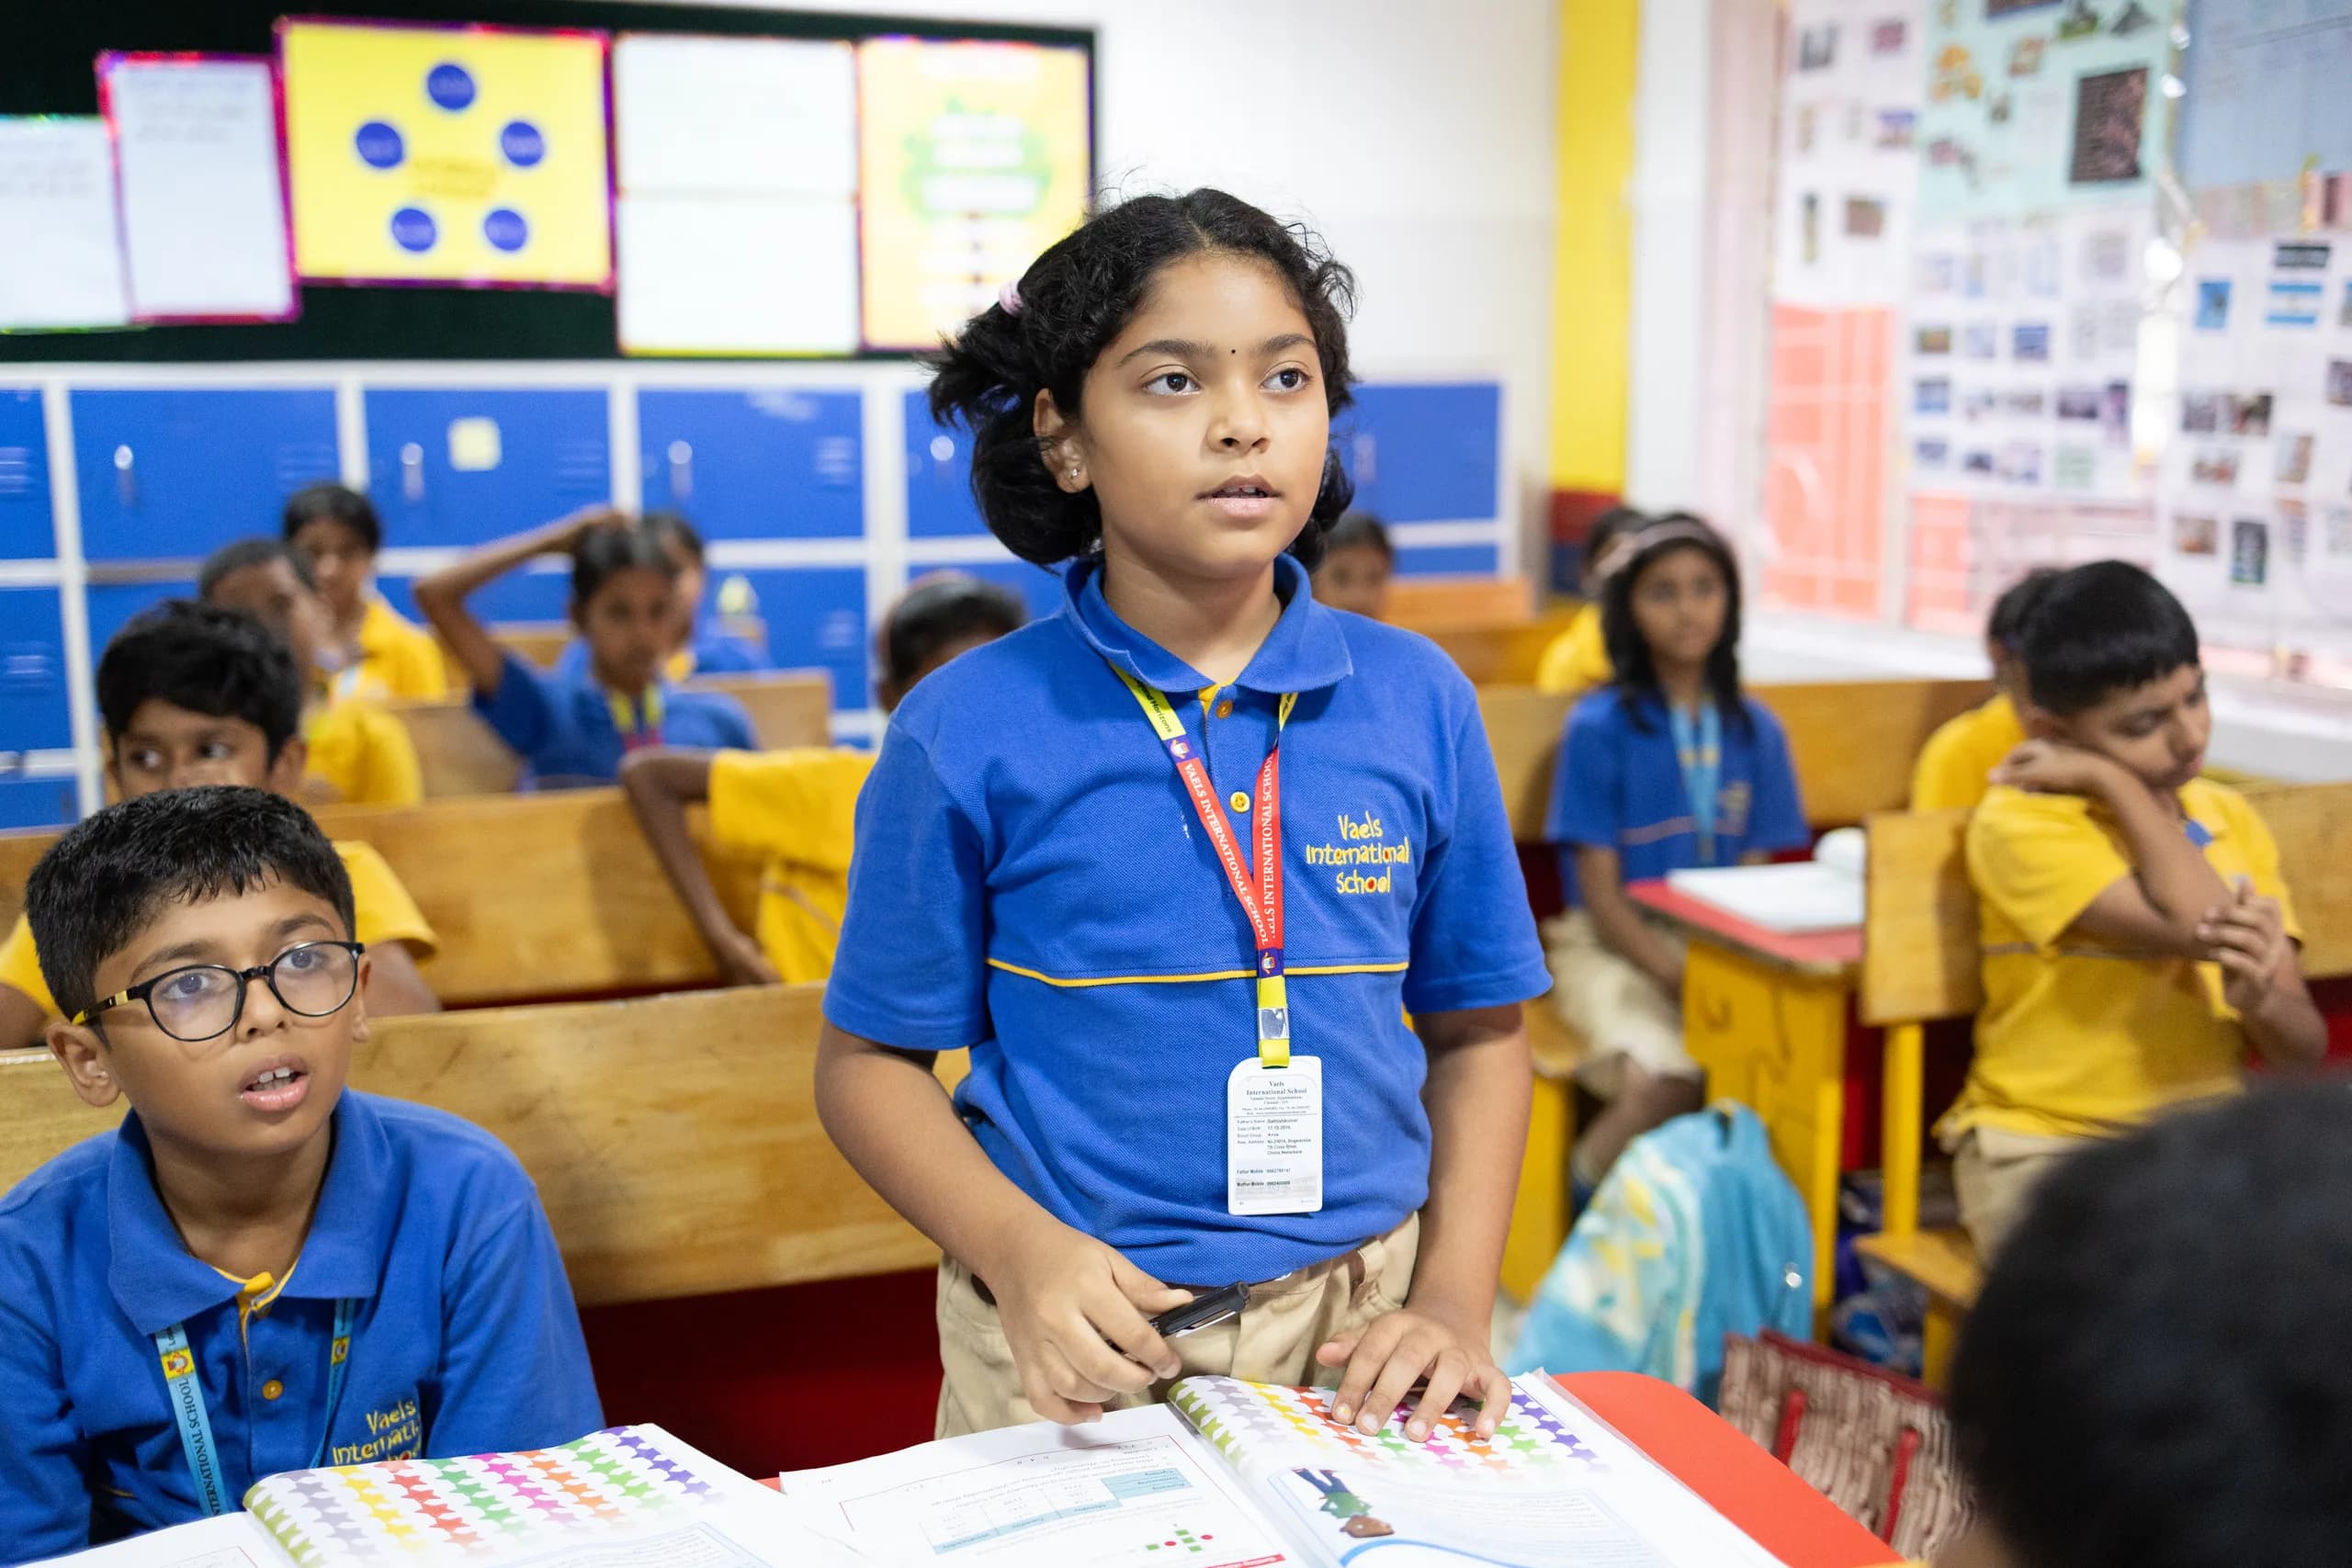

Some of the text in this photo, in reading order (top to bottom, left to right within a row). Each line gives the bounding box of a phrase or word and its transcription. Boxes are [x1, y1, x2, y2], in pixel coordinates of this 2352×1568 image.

[1151, 698, 1172, 732] Horizons
[1337, 810, 1384, 840] Vaels
[1184, 762, 1269, 945] VAELS INTERNATIONAL SCHOOL
[1261, 803, 1275, 906] INTERNATIONAL
[1306, 836, 1410, 865] International
[1336, 866, 1391, 895] School
[1263, 908, 1275, 939] ELS
[178, 1378, 201, 1430] SCHOOL
[366, 1400, 416, 1436] Vaels
[333, 1419, 419, 1465] Internati
